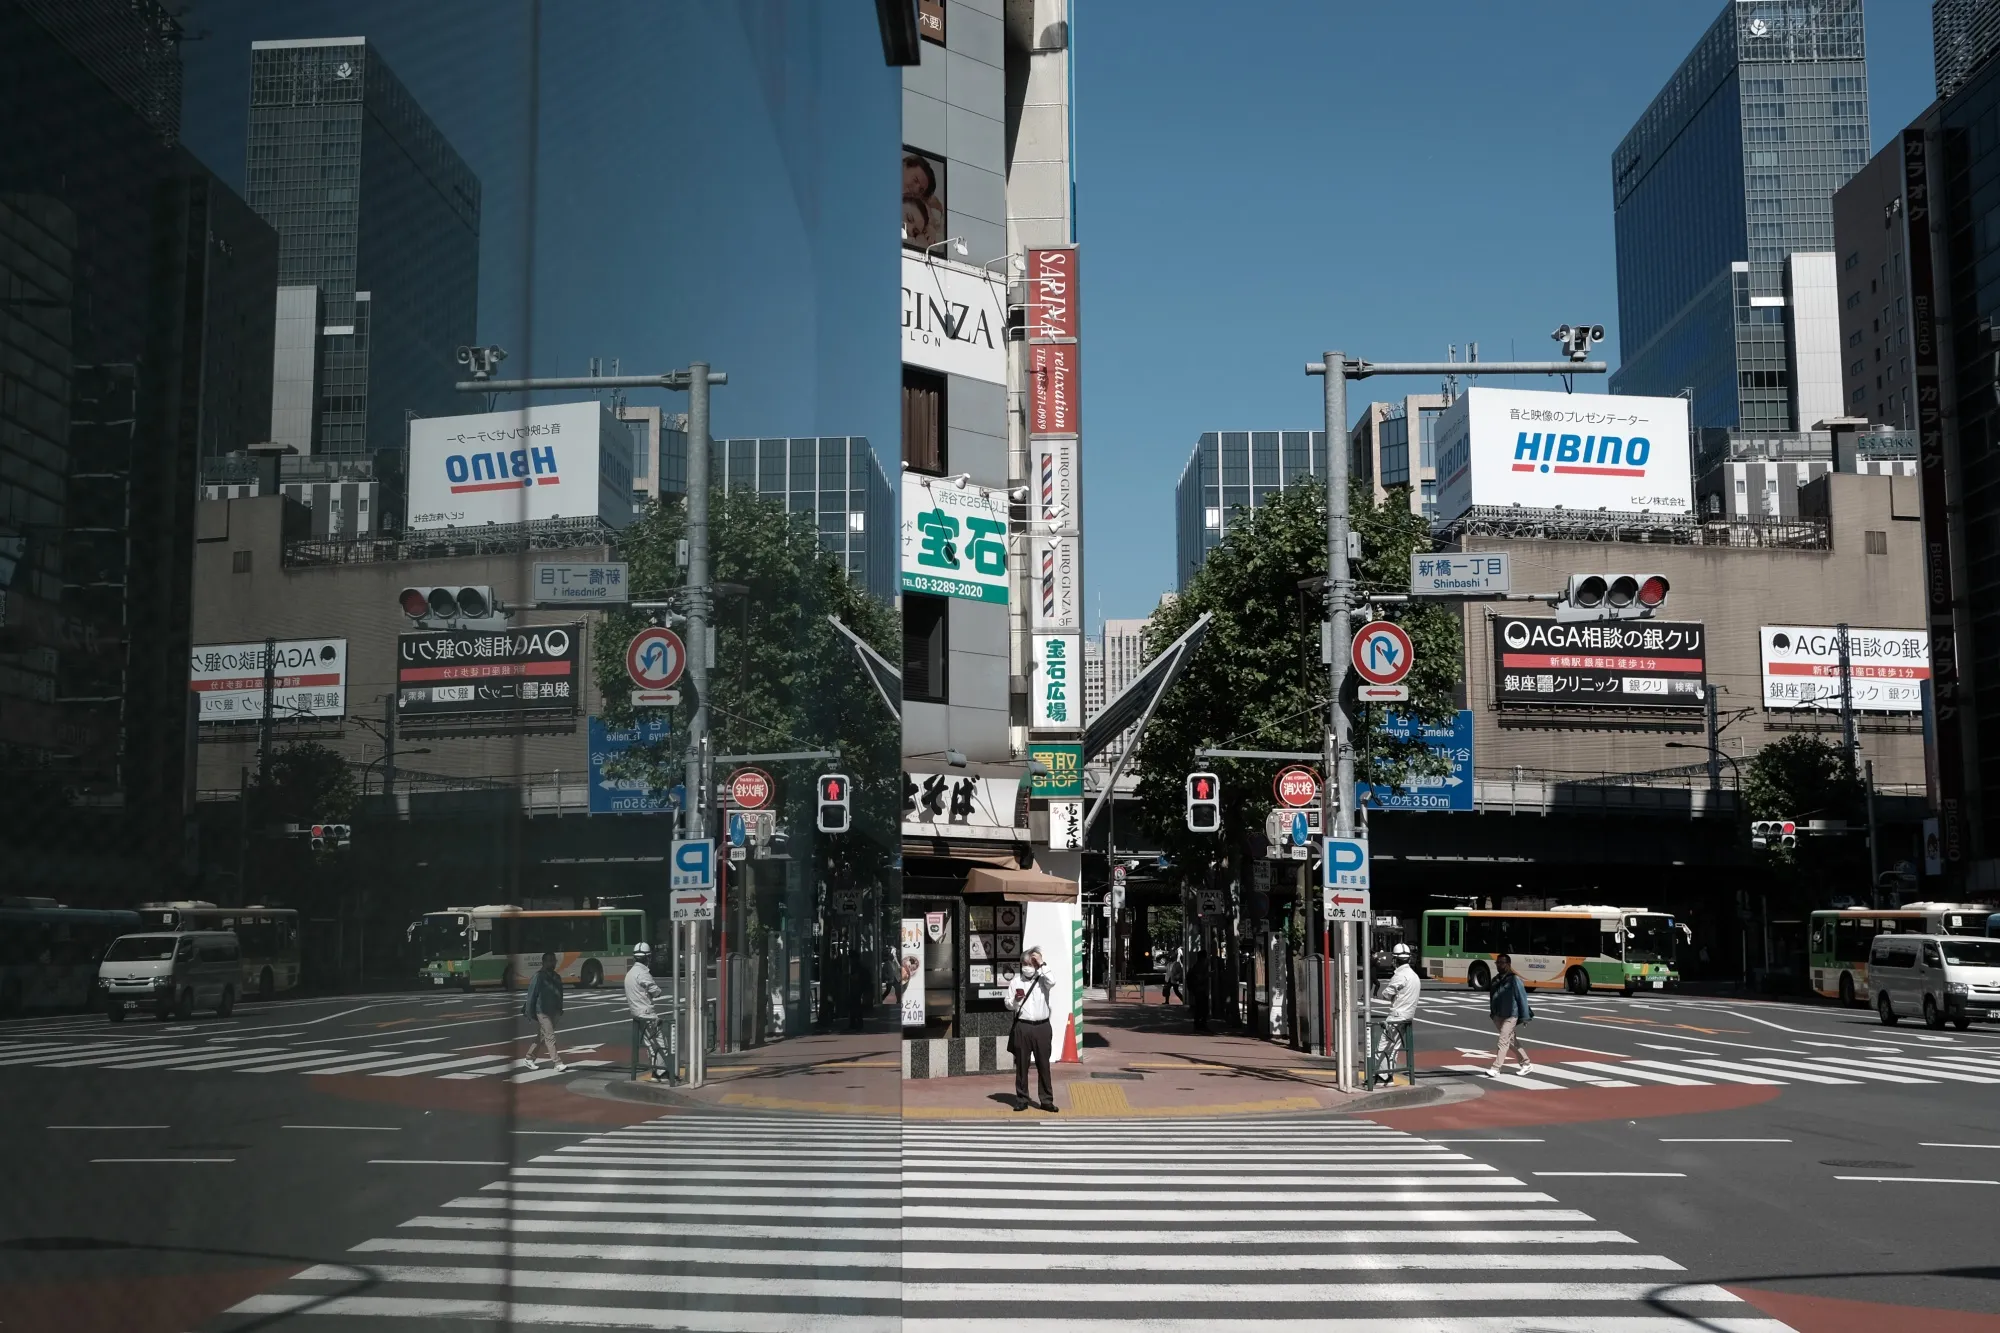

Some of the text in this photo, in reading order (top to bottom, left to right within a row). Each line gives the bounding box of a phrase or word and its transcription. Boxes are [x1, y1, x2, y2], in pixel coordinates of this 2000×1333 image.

[1039, 251, 1066, 337] SARINA
[1054, 351, 1069, 429] relaxation
[1509, 408, 1649, 426] 音と映像のプレゼンテーター
[939, 490, 1008, 514] 渋谷で25年以上
[1631, 496, 1686, 507] ヒビノ株式会社
[917, 508, 1009, 577] 宝石
[1418, 558, 1502, 577] 新橋一丁目
[1433, 578, 1489, 588] Shinbashi 1
[1061, 577, 1072, 616] GINZA
[1058, 618, 1072, 627] 3F
[1530, 625, 1700, 650] AGA相談の銀クリ
[1550, 657, 1657, 669] 新橋駅 銀座口 徒歩1分
[1046, 638, 1067, 722] 宝石広場
[1628, 679, 1695, 693] 銀クリ 検索
[1934, 635, 1957, 720] カラオケ
[1033, 751, 1077, 775] 買取
[1032, 774, 1078, 788] SHOP
[1283, 781, 1313, 796] 消火栓
[1065, 803, 1082, 849] 富士そば
[1328, 841, 1364, 884] P
[1327, 908, 1346, 918] この先
[1351, 908, 1367, 919] 40m
